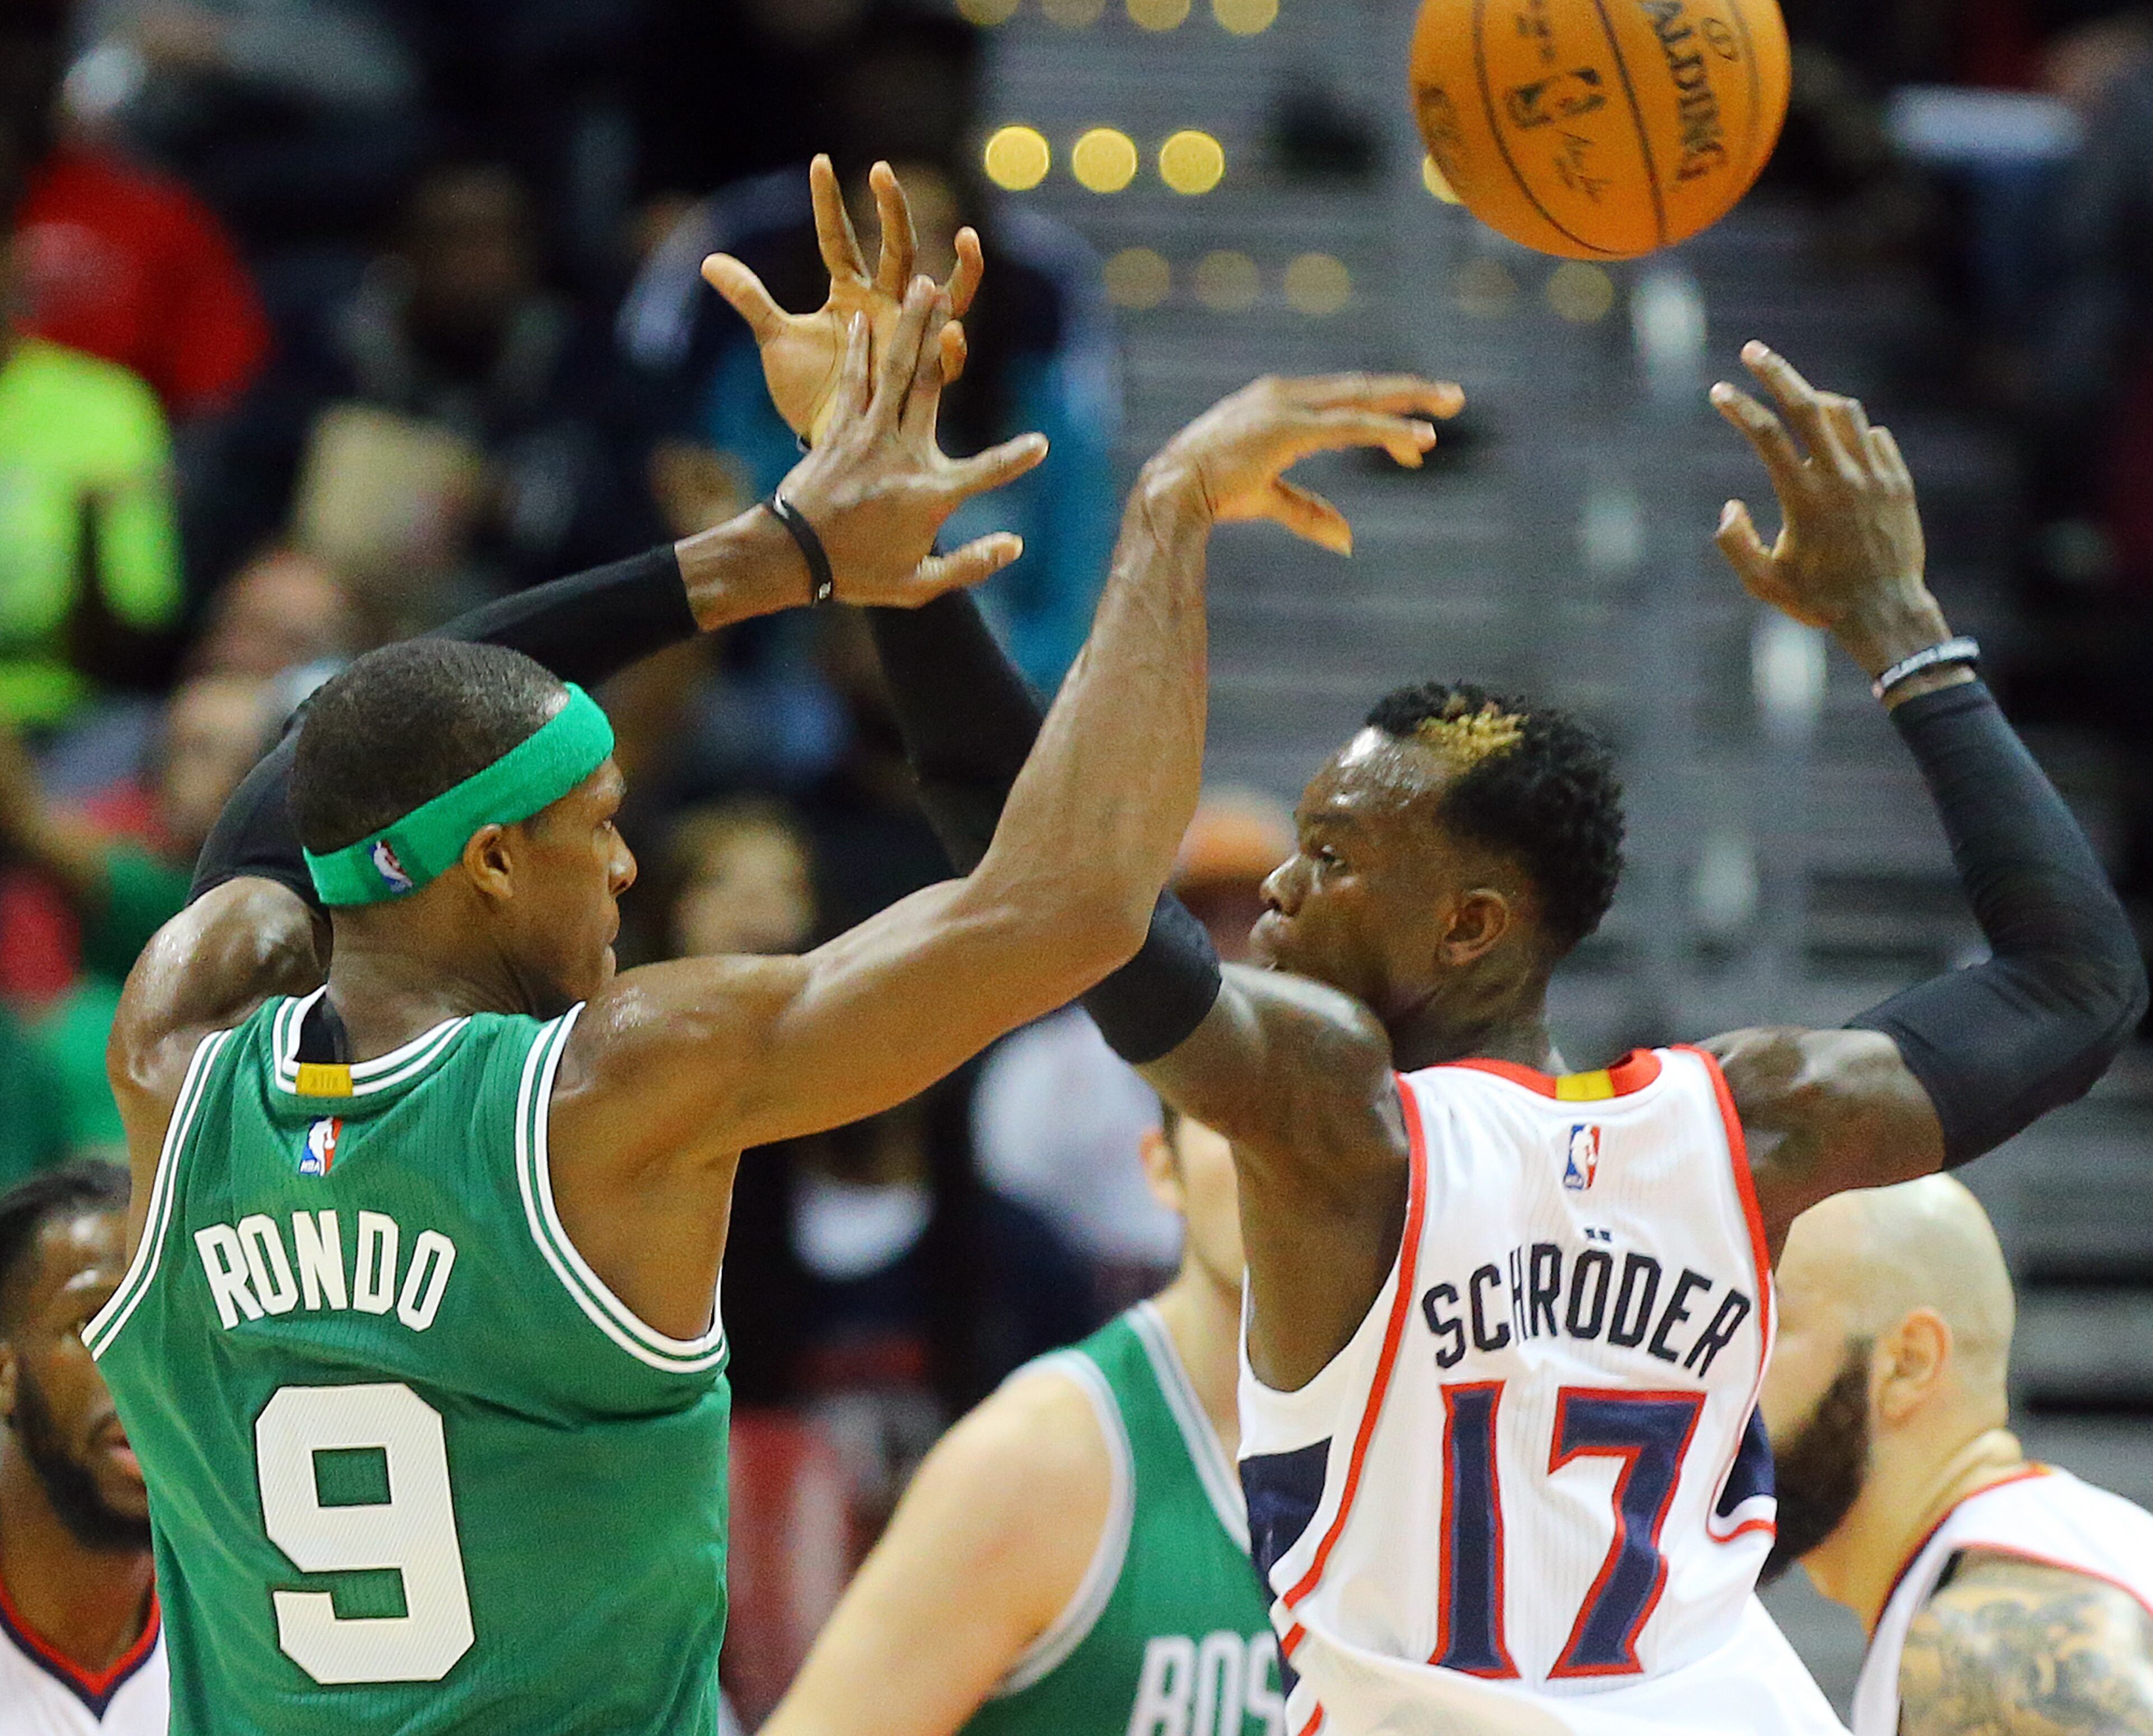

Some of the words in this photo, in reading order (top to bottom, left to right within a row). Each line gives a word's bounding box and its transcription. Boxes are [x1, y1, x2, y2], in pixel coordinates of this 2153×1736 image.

[194, 1210, 456, 1332] RONDO
[255, 1383, 475, 1684] 9
[1427, 1379, 1708, 1679] 17
